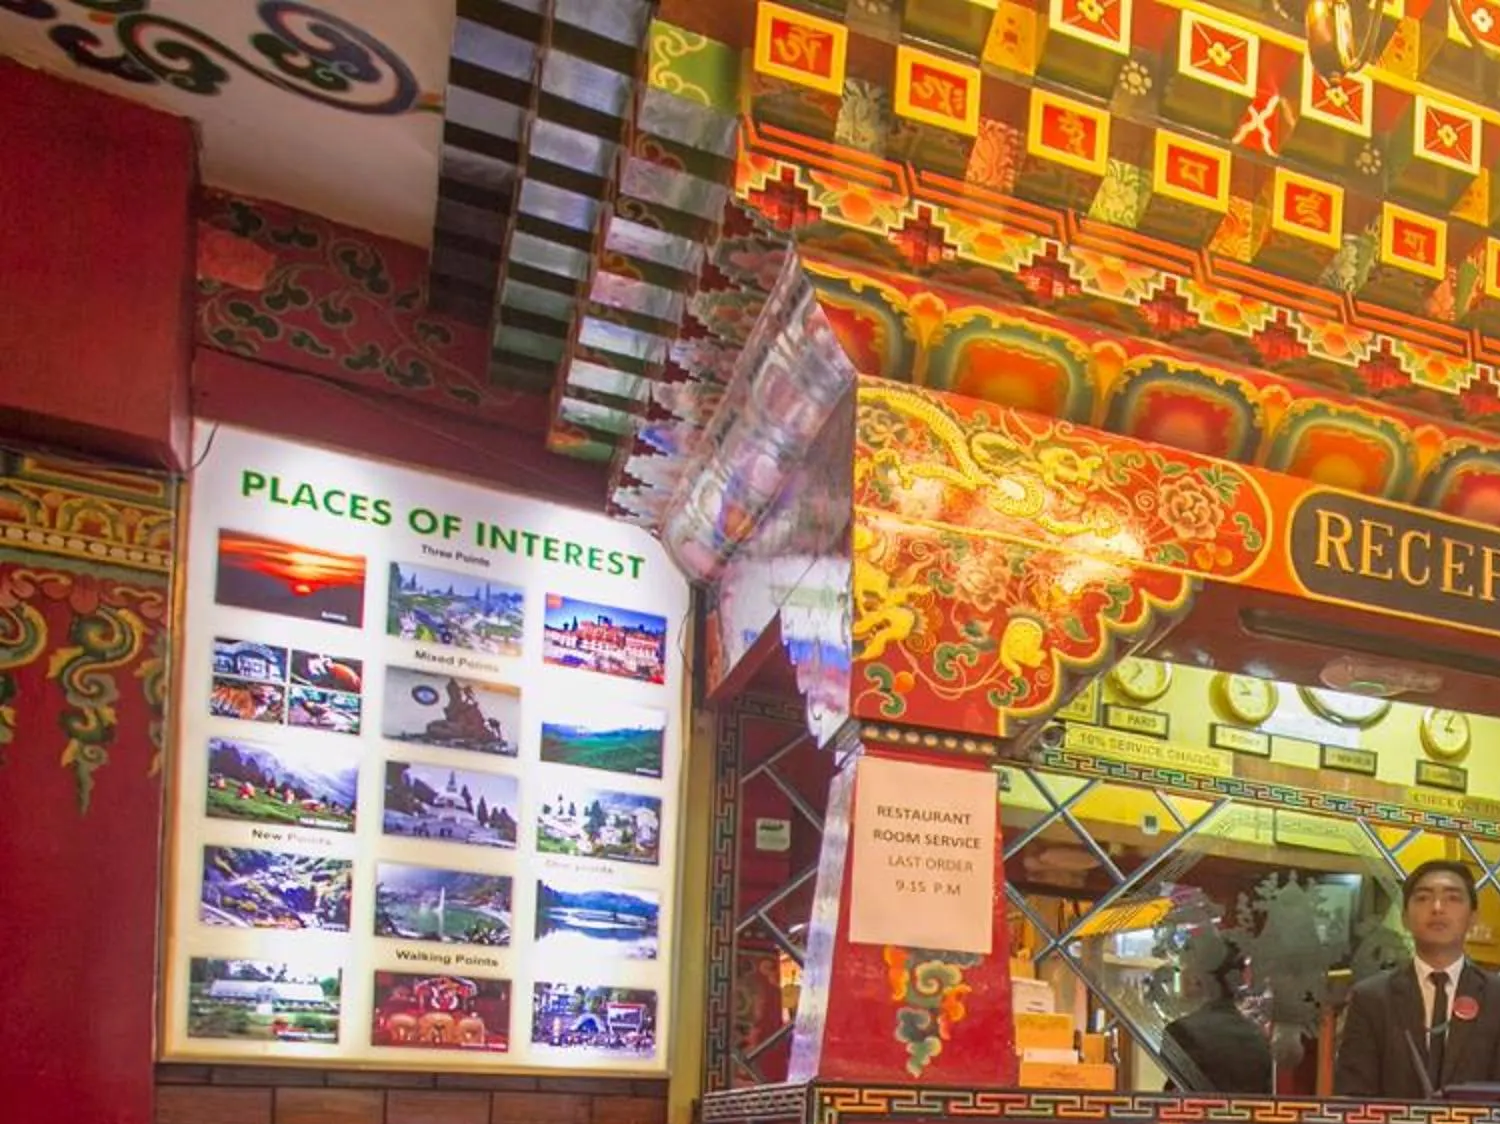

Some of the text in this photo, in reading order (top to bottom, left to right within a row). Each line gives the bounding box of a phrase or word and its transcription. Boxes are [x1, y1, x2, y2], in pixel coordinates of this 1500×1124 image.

[241, 470, 647, 580] PLACES OF INTEREST
[421, 544, 491, 568] Three Points
[415, 649, 454, 666] Mixed
[1109, 736, 1164, 758] SERVICE
[877, 805, 971, 825] RESTAURANT
[252, 828, 282, 840] New
[873, 828, 982, 849] ROOM SERVICE
[888, 855, 973, 873] LAST ORDER
[395, 949, 500, 967] Walking Points
